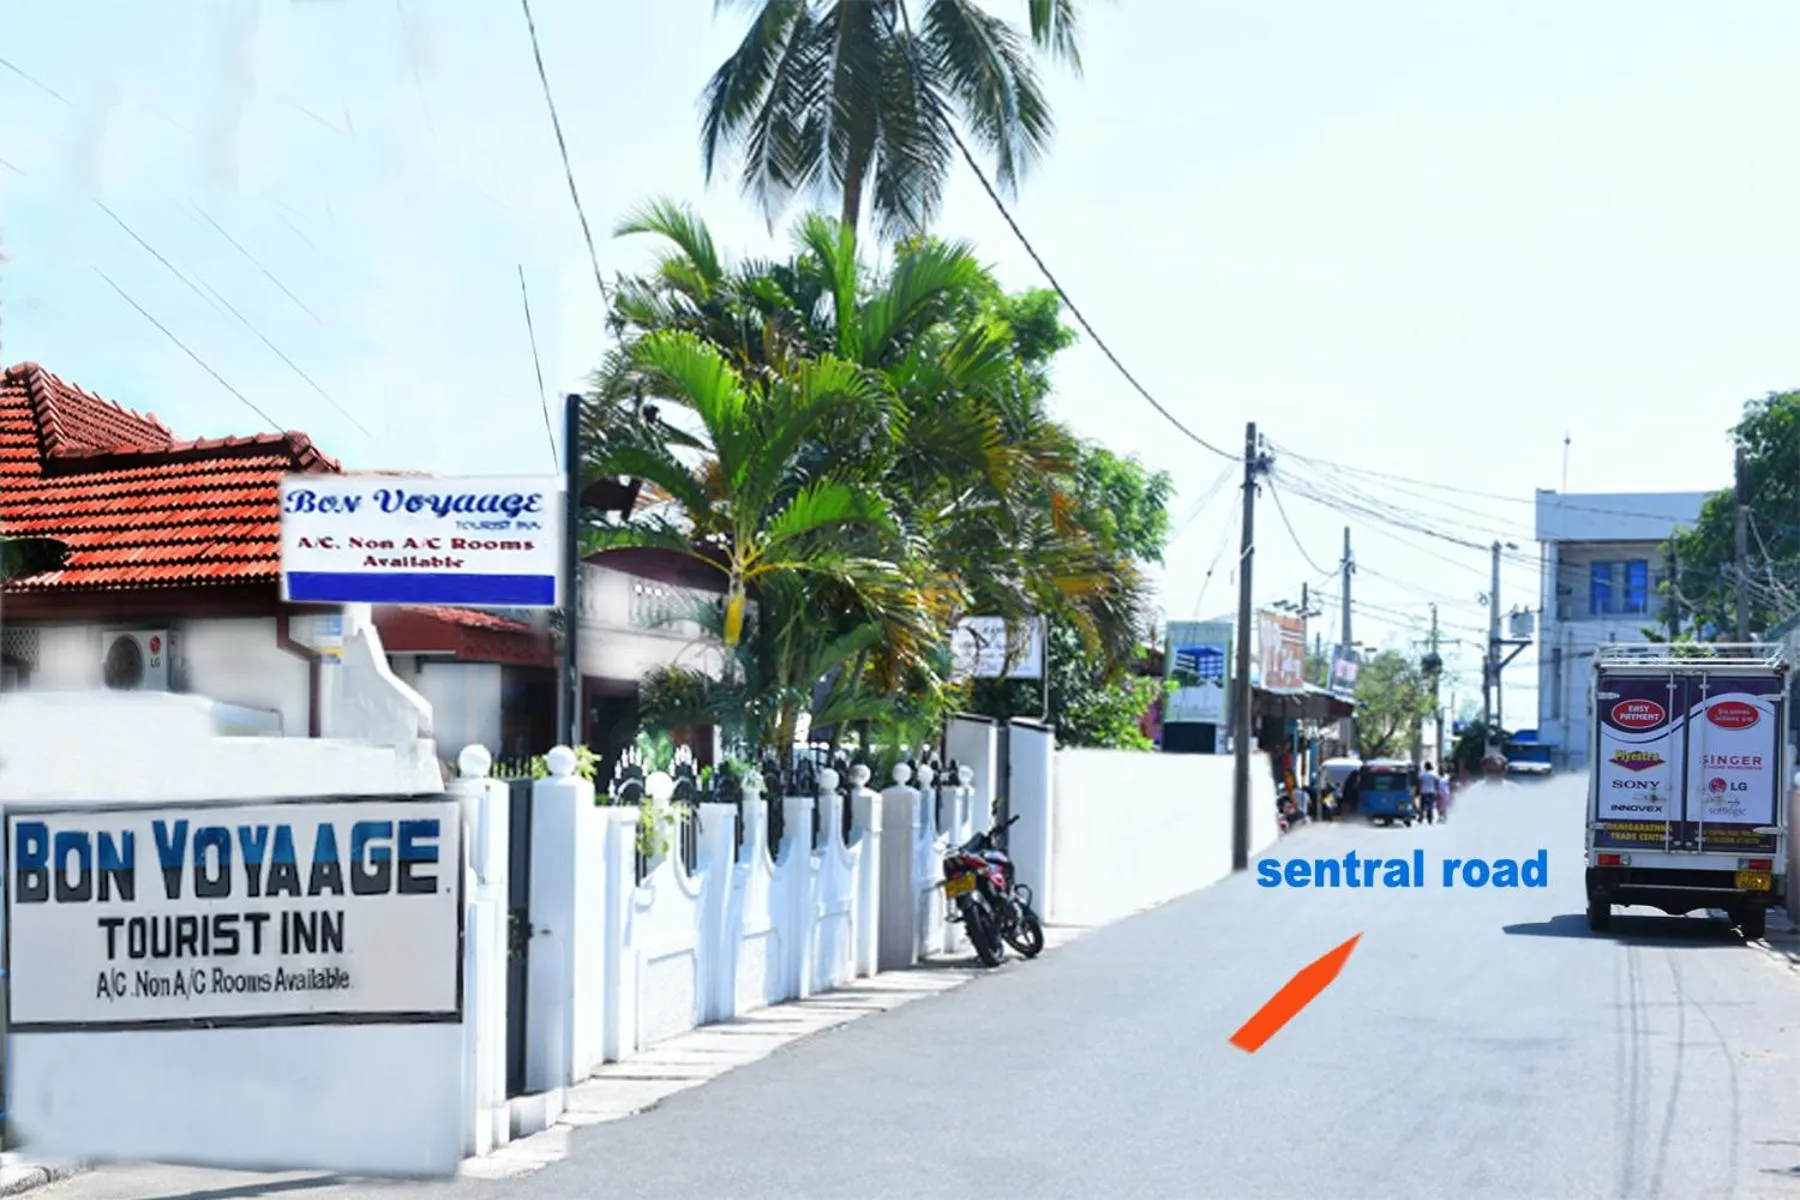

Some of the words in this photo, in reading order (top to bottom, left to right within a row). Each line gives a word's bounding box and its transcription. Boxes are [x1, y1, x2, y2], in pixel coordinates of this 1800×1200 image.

[284, 489, 362, 513] Bon
[348, 536, 394, 549] Non
[402, 537, 441, 550] A/C
[451, 538, 535, 550] Rooms
[363, 556, 465, 568] Available
[1702, 754, 1763, 766] SINGER
[1612, 779, 1660, 789] SONY
[1730, 781, 1748, 792] LG
[1610, 804, 1663, 813] INNOVEX
[15, 821, 135, 903] BON
[98, 913, 270, 960] TOURIST
[280, 911, 344, 954] INN
